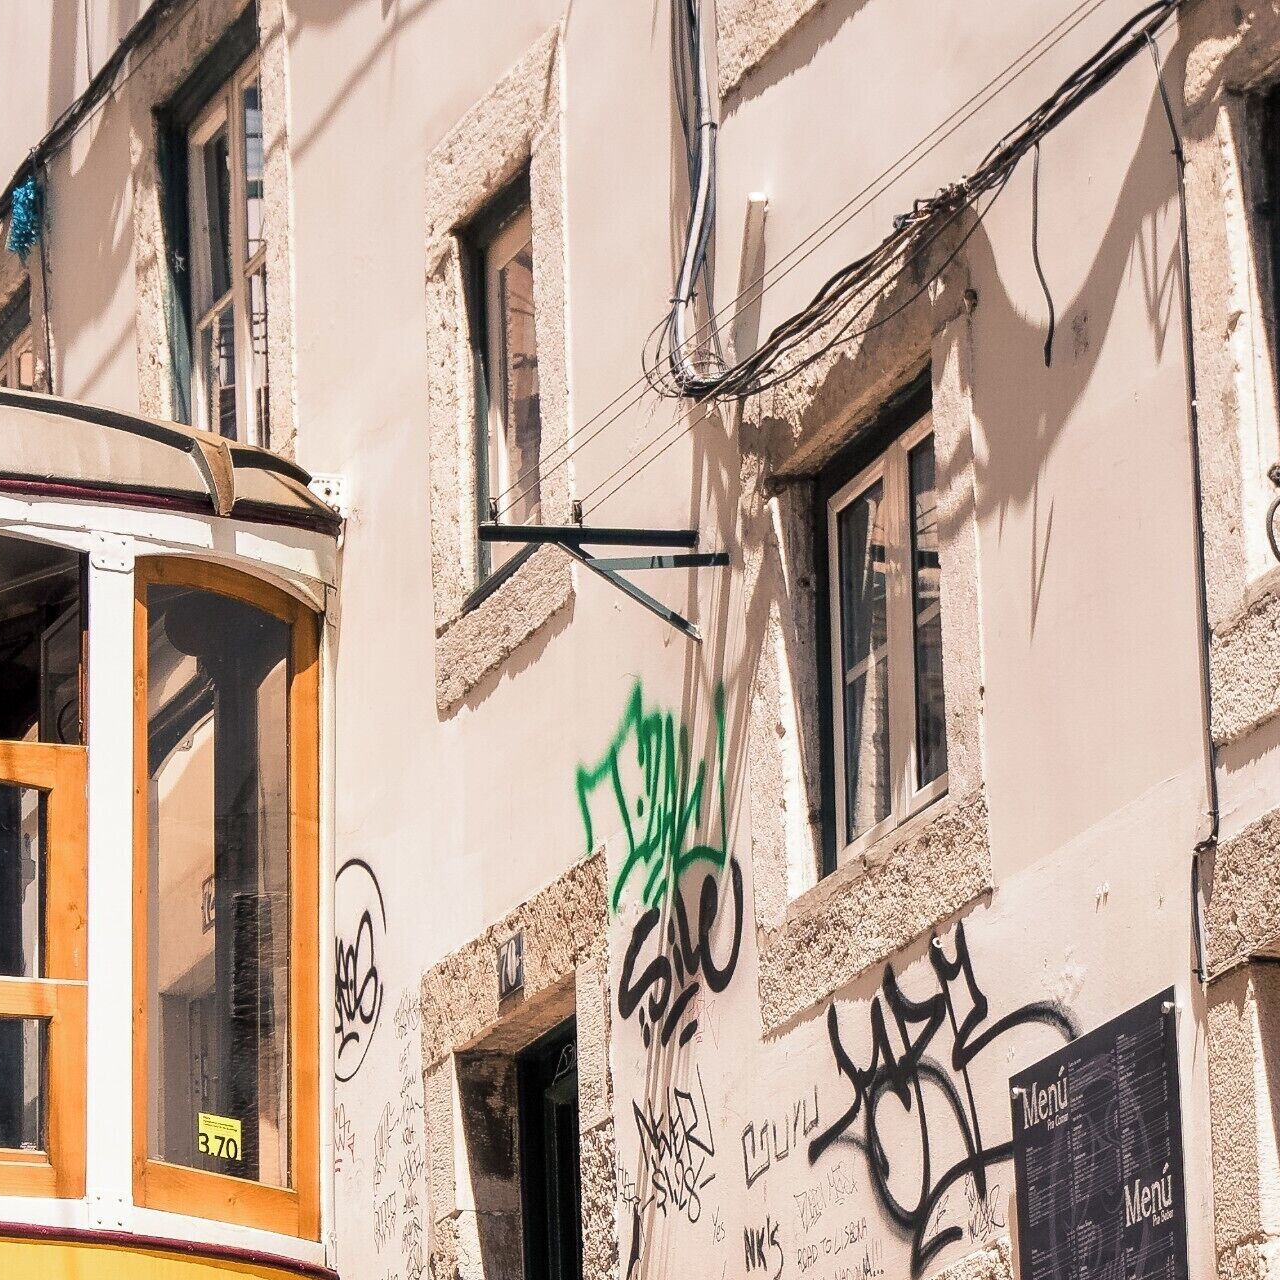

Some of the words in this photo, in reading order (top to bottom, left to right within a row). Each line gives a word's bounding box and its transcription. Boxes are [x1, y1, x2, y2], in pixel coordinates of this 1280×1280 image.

[499, 940, 518, 994] 70
[1022, 1065, 1068, 1130] Menú
[197, 1132, 238, 1160] 3.70
[1123, 1162, 1173, 1228] Menú
